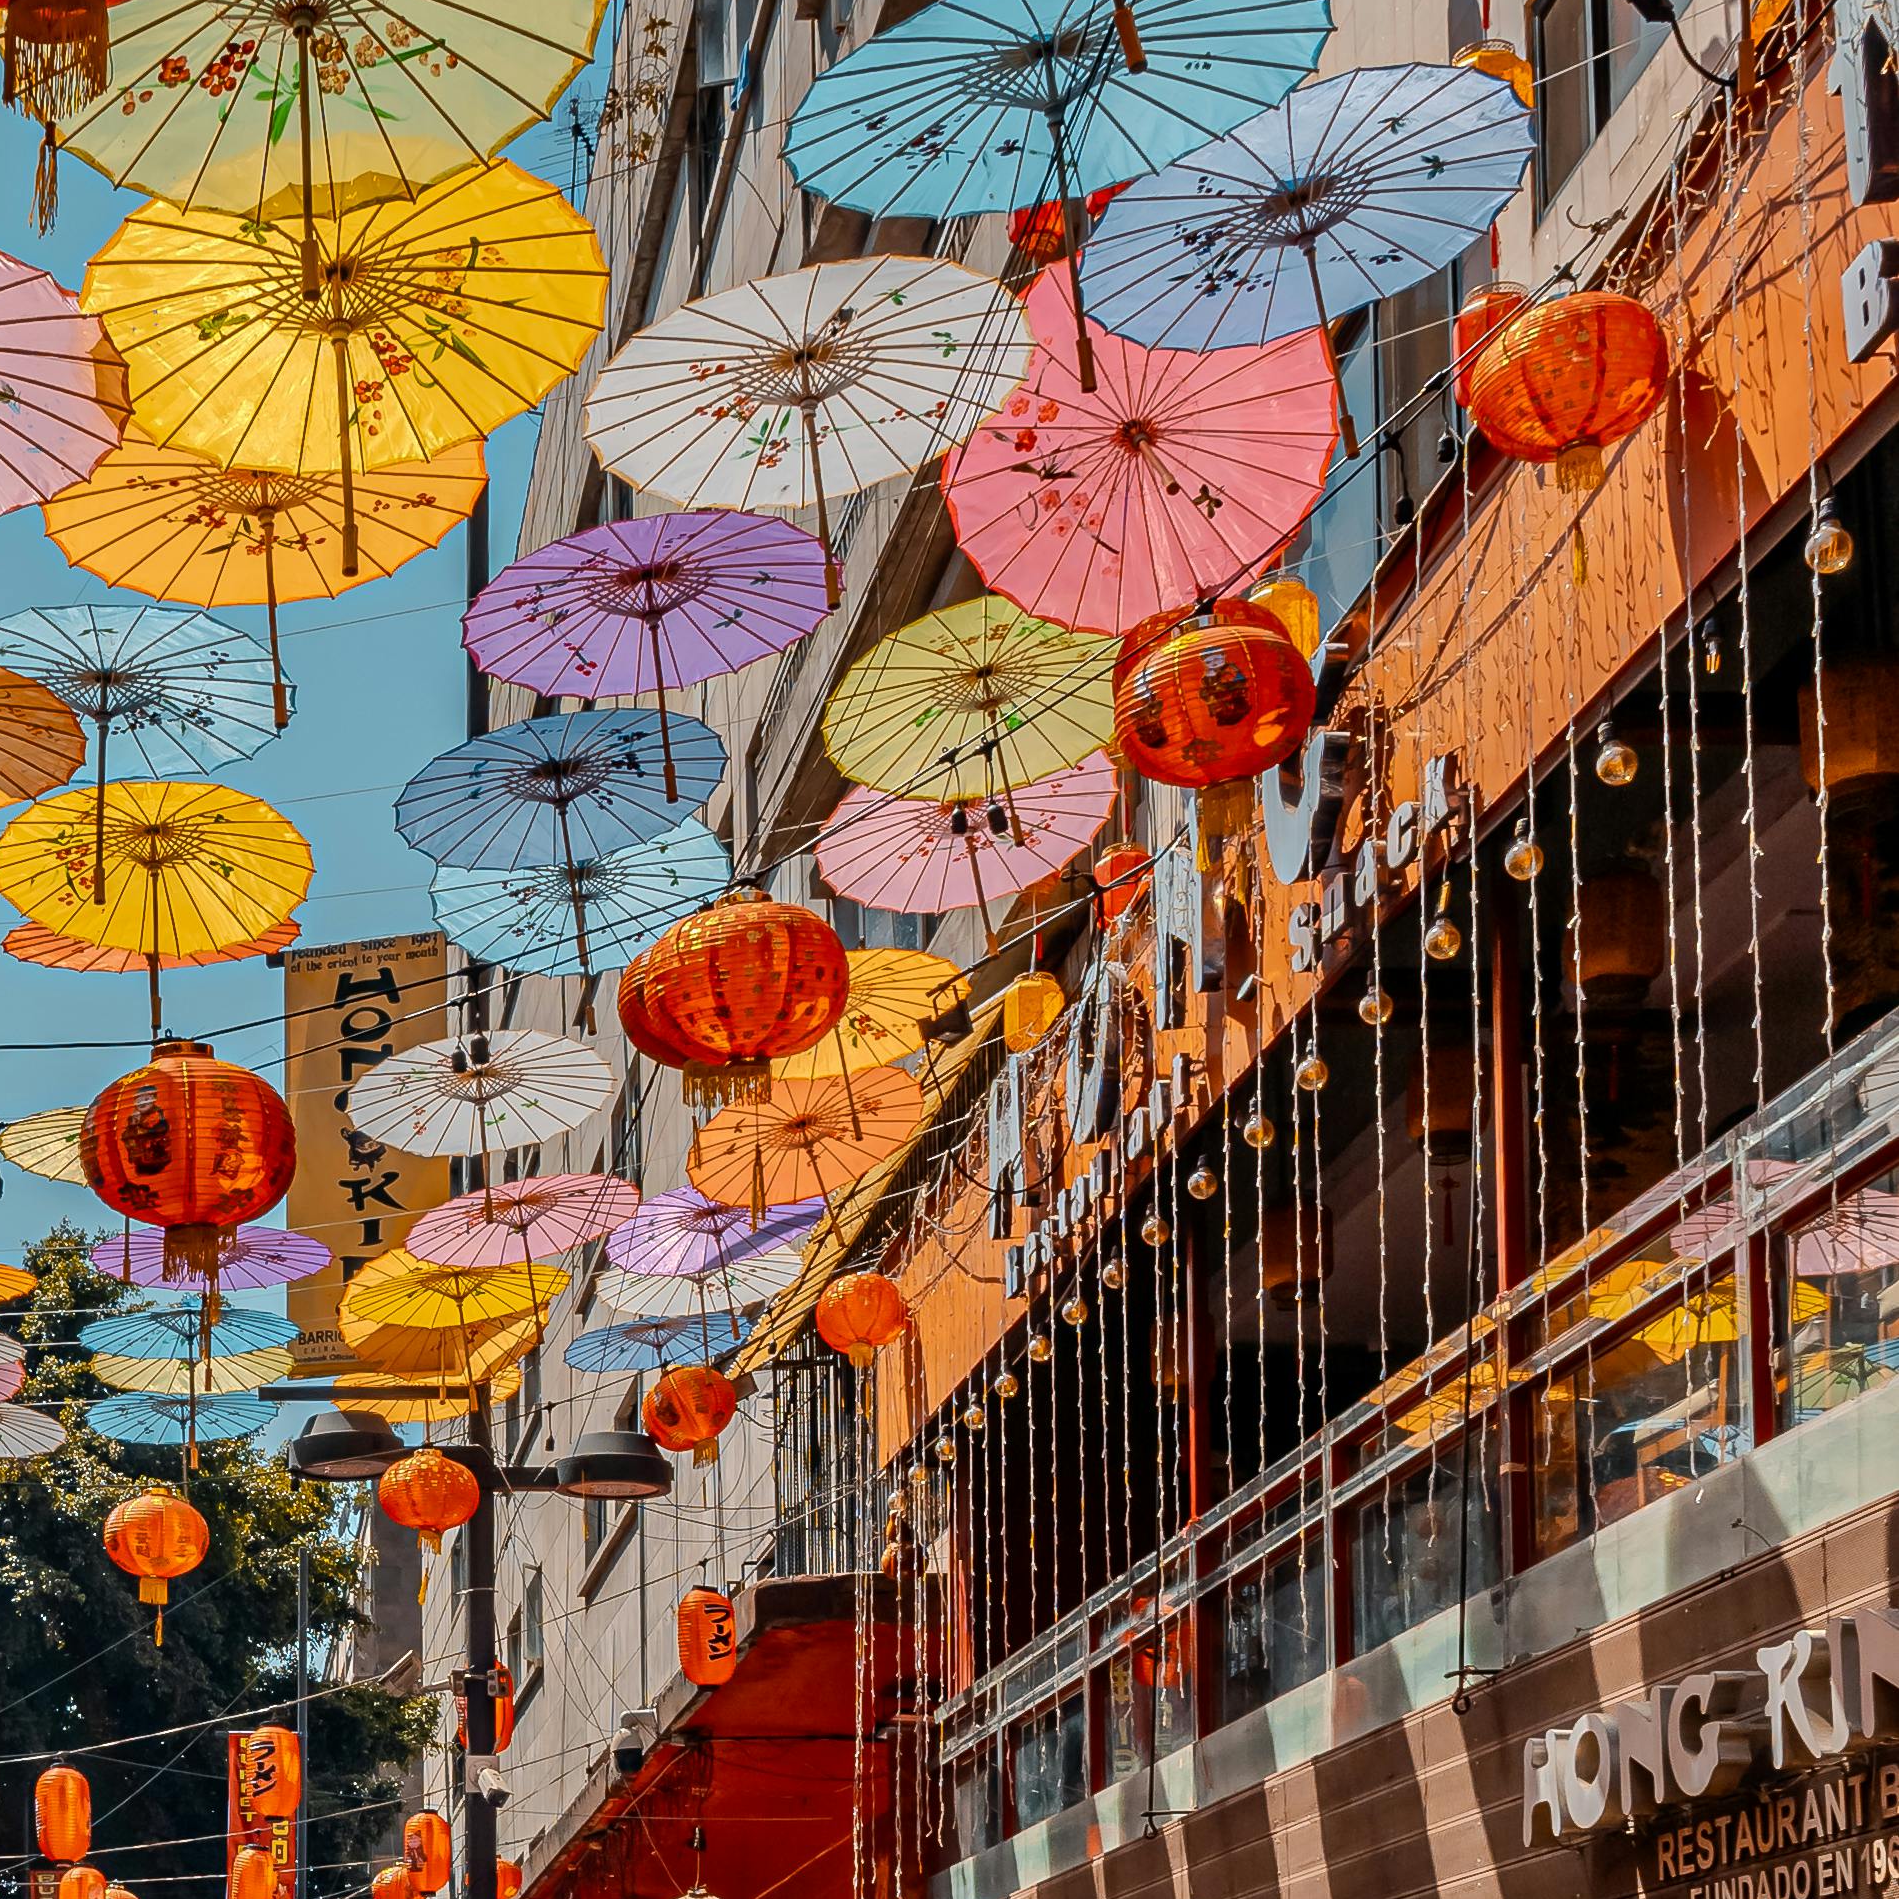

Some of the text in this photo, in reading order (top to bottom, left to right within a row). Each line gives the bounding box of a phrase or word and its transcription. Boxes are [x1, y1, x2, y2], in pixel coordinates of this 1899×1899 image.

[306, 958, 323, 972] the
[376, 950, 402, 966] your
[405, 945, 440, 960] mouth
[704, 1604, 731, 1661] ラーメン
[250, 1740, 277, 1798] ラーメン
[1524, 1673, 1723, 1848] HONG
[1658, 1776, 1868, 1882] RESTAURANT
[1818, 1847, 1853, 1897] EN
